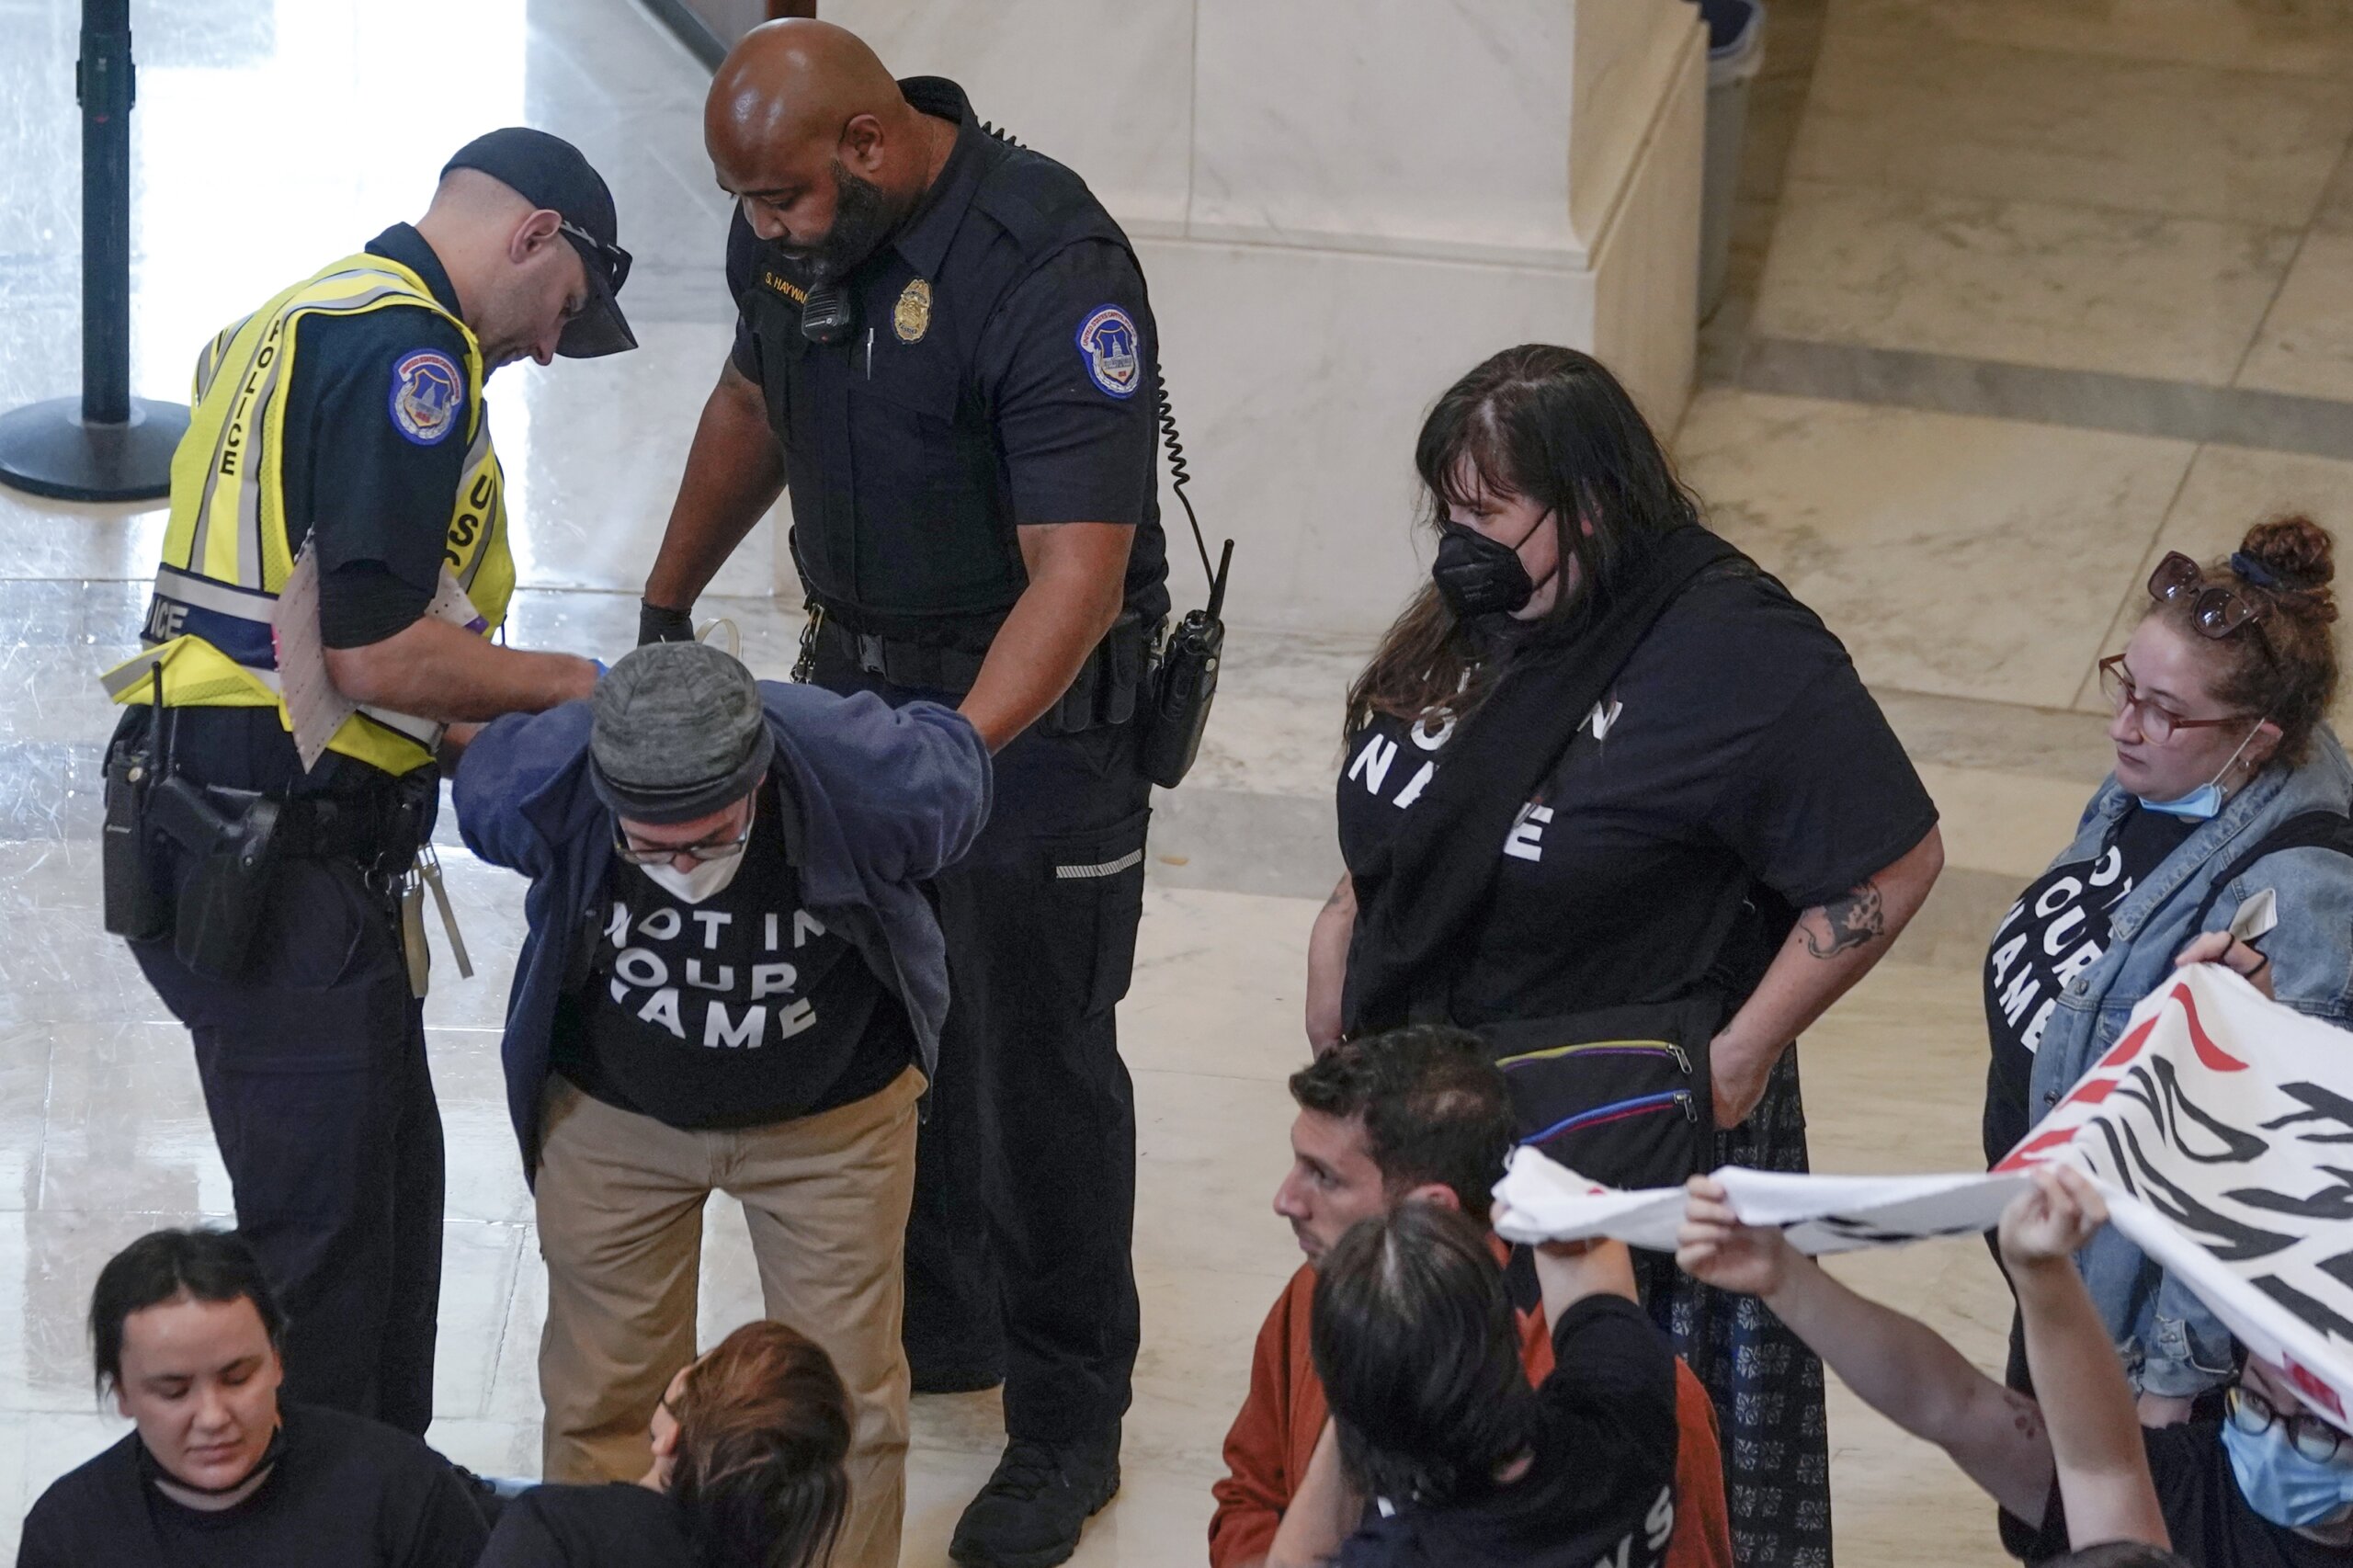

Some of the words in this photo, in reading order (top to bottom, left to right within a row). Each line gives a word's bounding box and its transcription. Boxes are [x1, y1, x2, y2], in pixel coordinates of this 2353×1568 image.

[773, 277, 808, 304] HAYWA
[615, 947, 798, 1001] OUR
[609, 977, 817, 1049] AME
